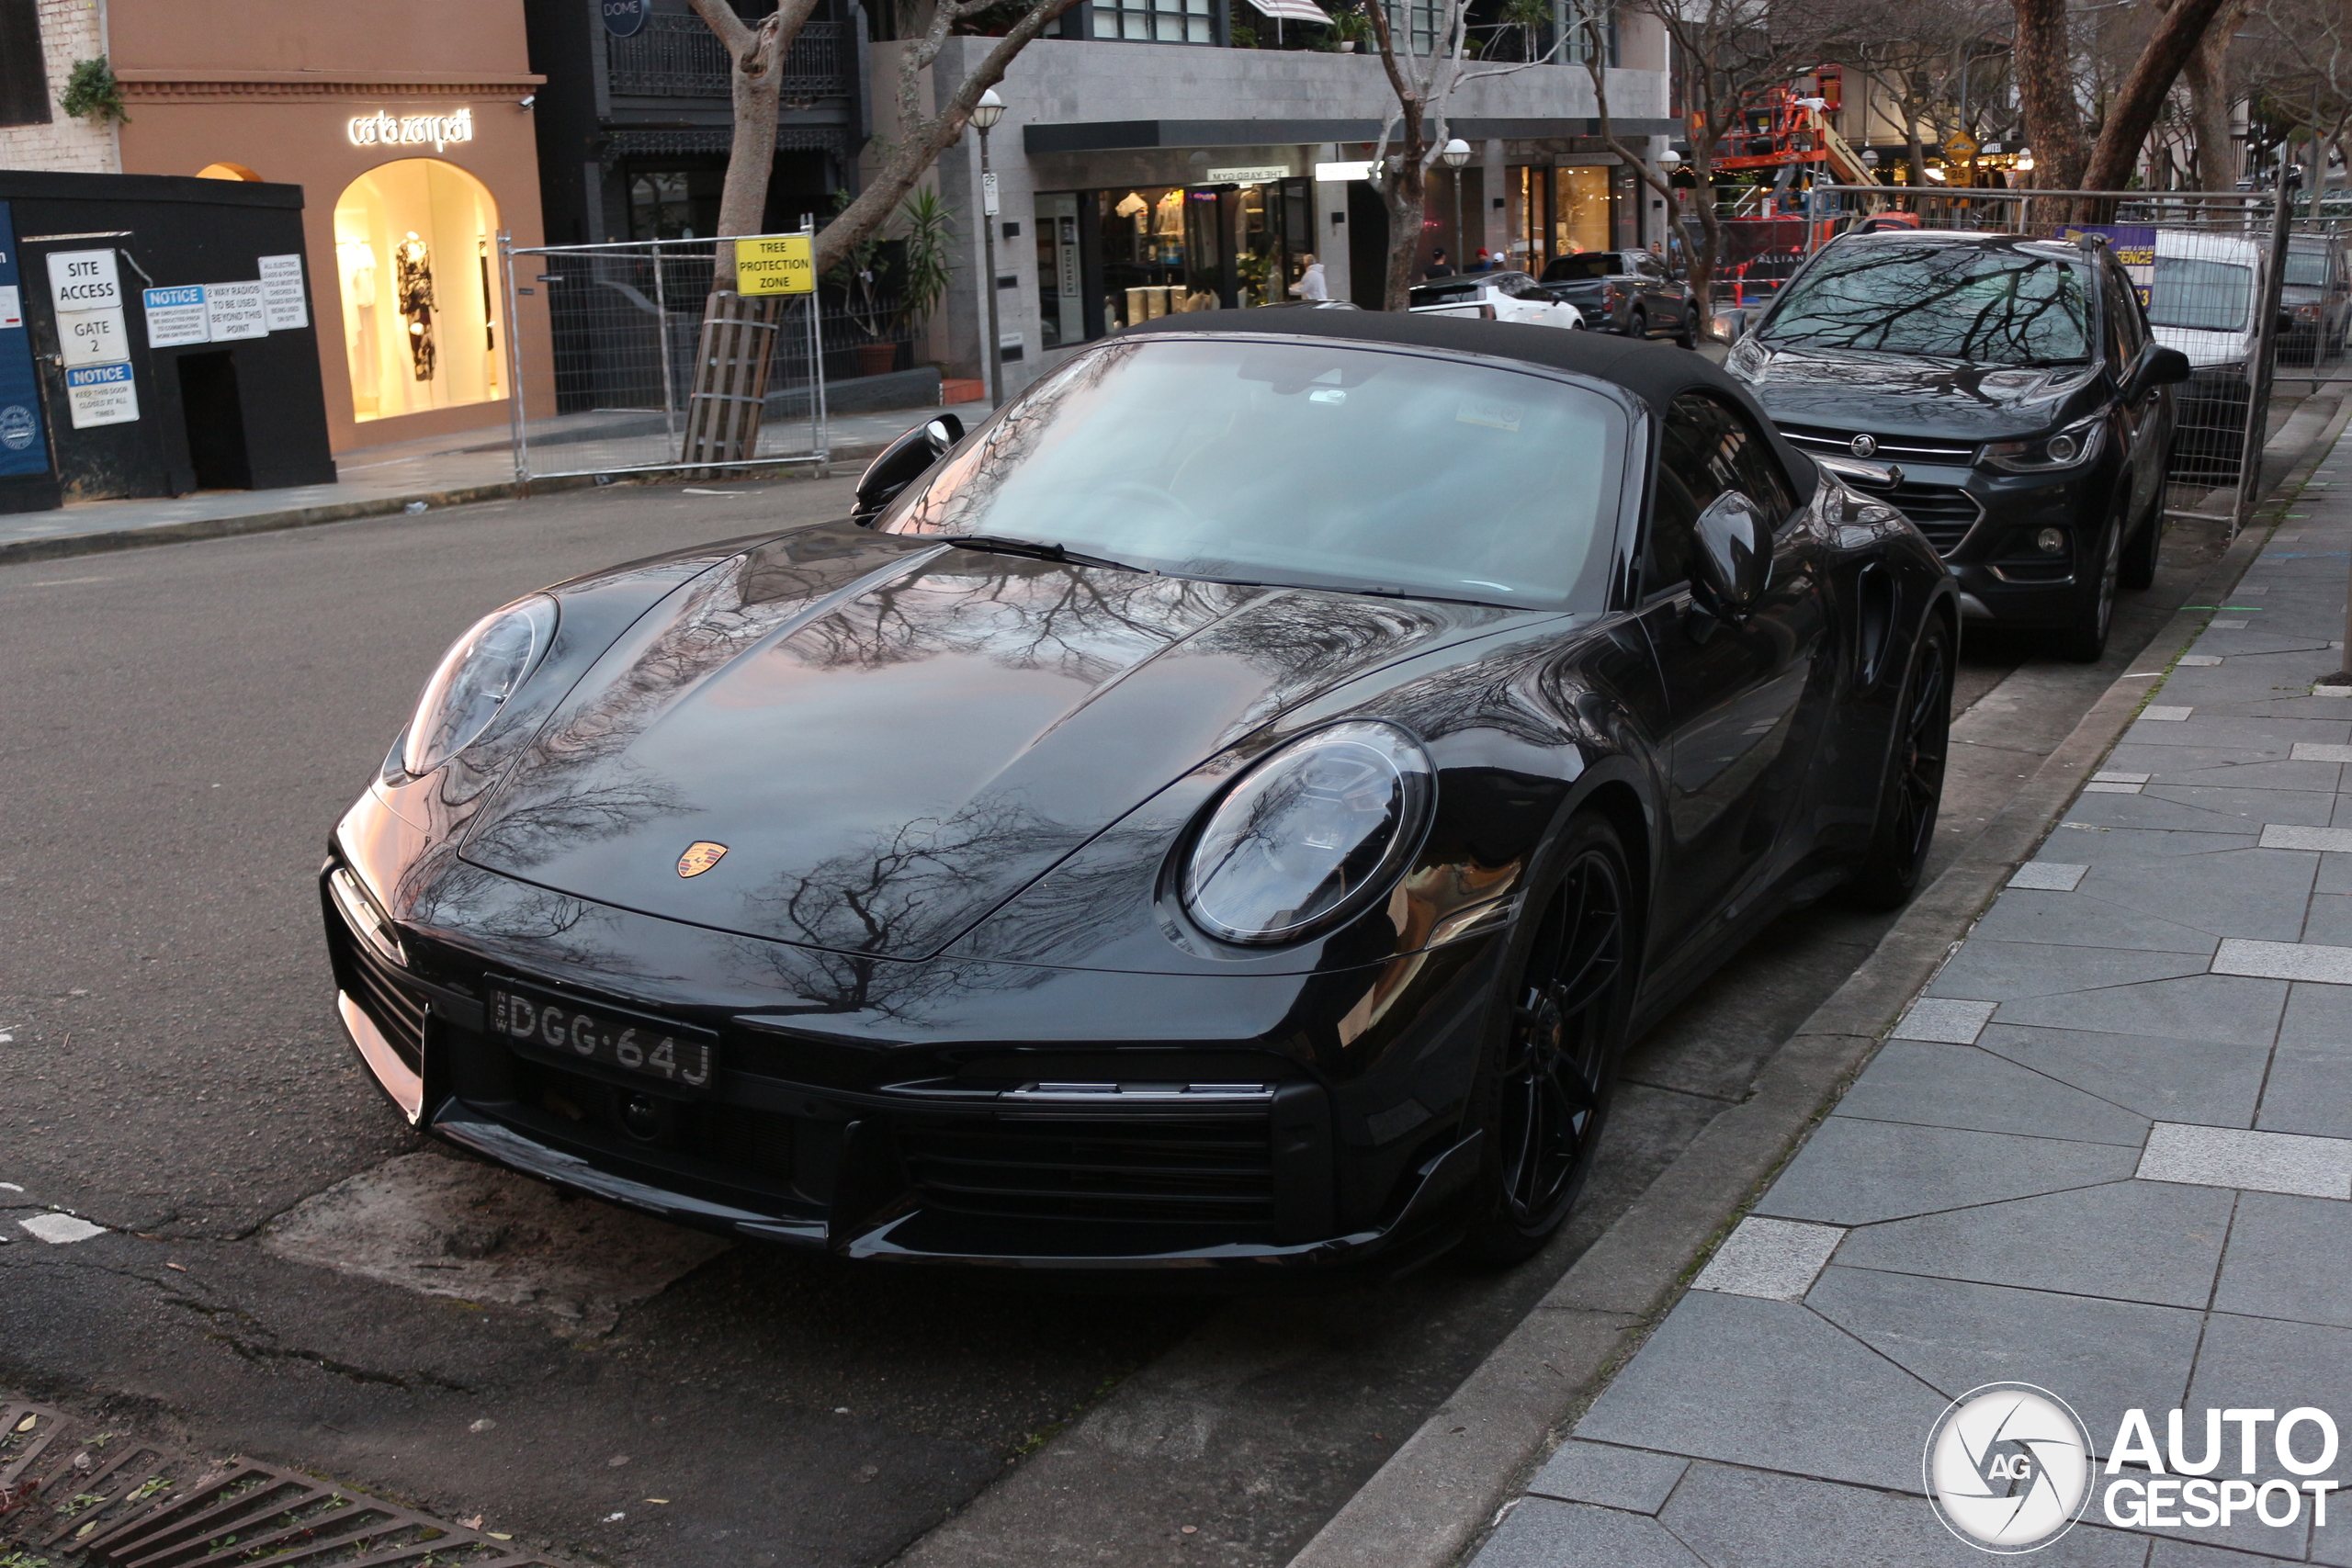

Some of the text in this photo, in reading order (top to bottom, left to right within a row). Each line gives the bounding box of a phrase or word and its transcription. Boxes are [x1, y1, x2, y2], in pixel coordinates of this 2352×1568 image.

[604, 0, 639, 16] DOME
[1951, 169, 1965, 179] 25
[759, 242, 786, 253] TREE
[740, 259, 808, 272] PROTECTION
[1757, 255, 1804, 264] ALLIAN
[68, 261, 99, 277] SITE
[759, 276, 790, 288] ZONE
[61, 283, 114, 300] ACCESS
[150, 288, 198, 305] NOTICE
[207, 285, 260, 298] 2 WAY RADIOS
[213, 298, 257, 310] TO BE USED
[212, 310, 262, 323] BEYOND THIS
[74, 321, 110, 336] GATE
[226, 323, 249, 334] POINT
[91, 340, 99, 352] 2
[74, 366, 124, 385] NOTICE
[496, 991, 507, 1032] NSW
